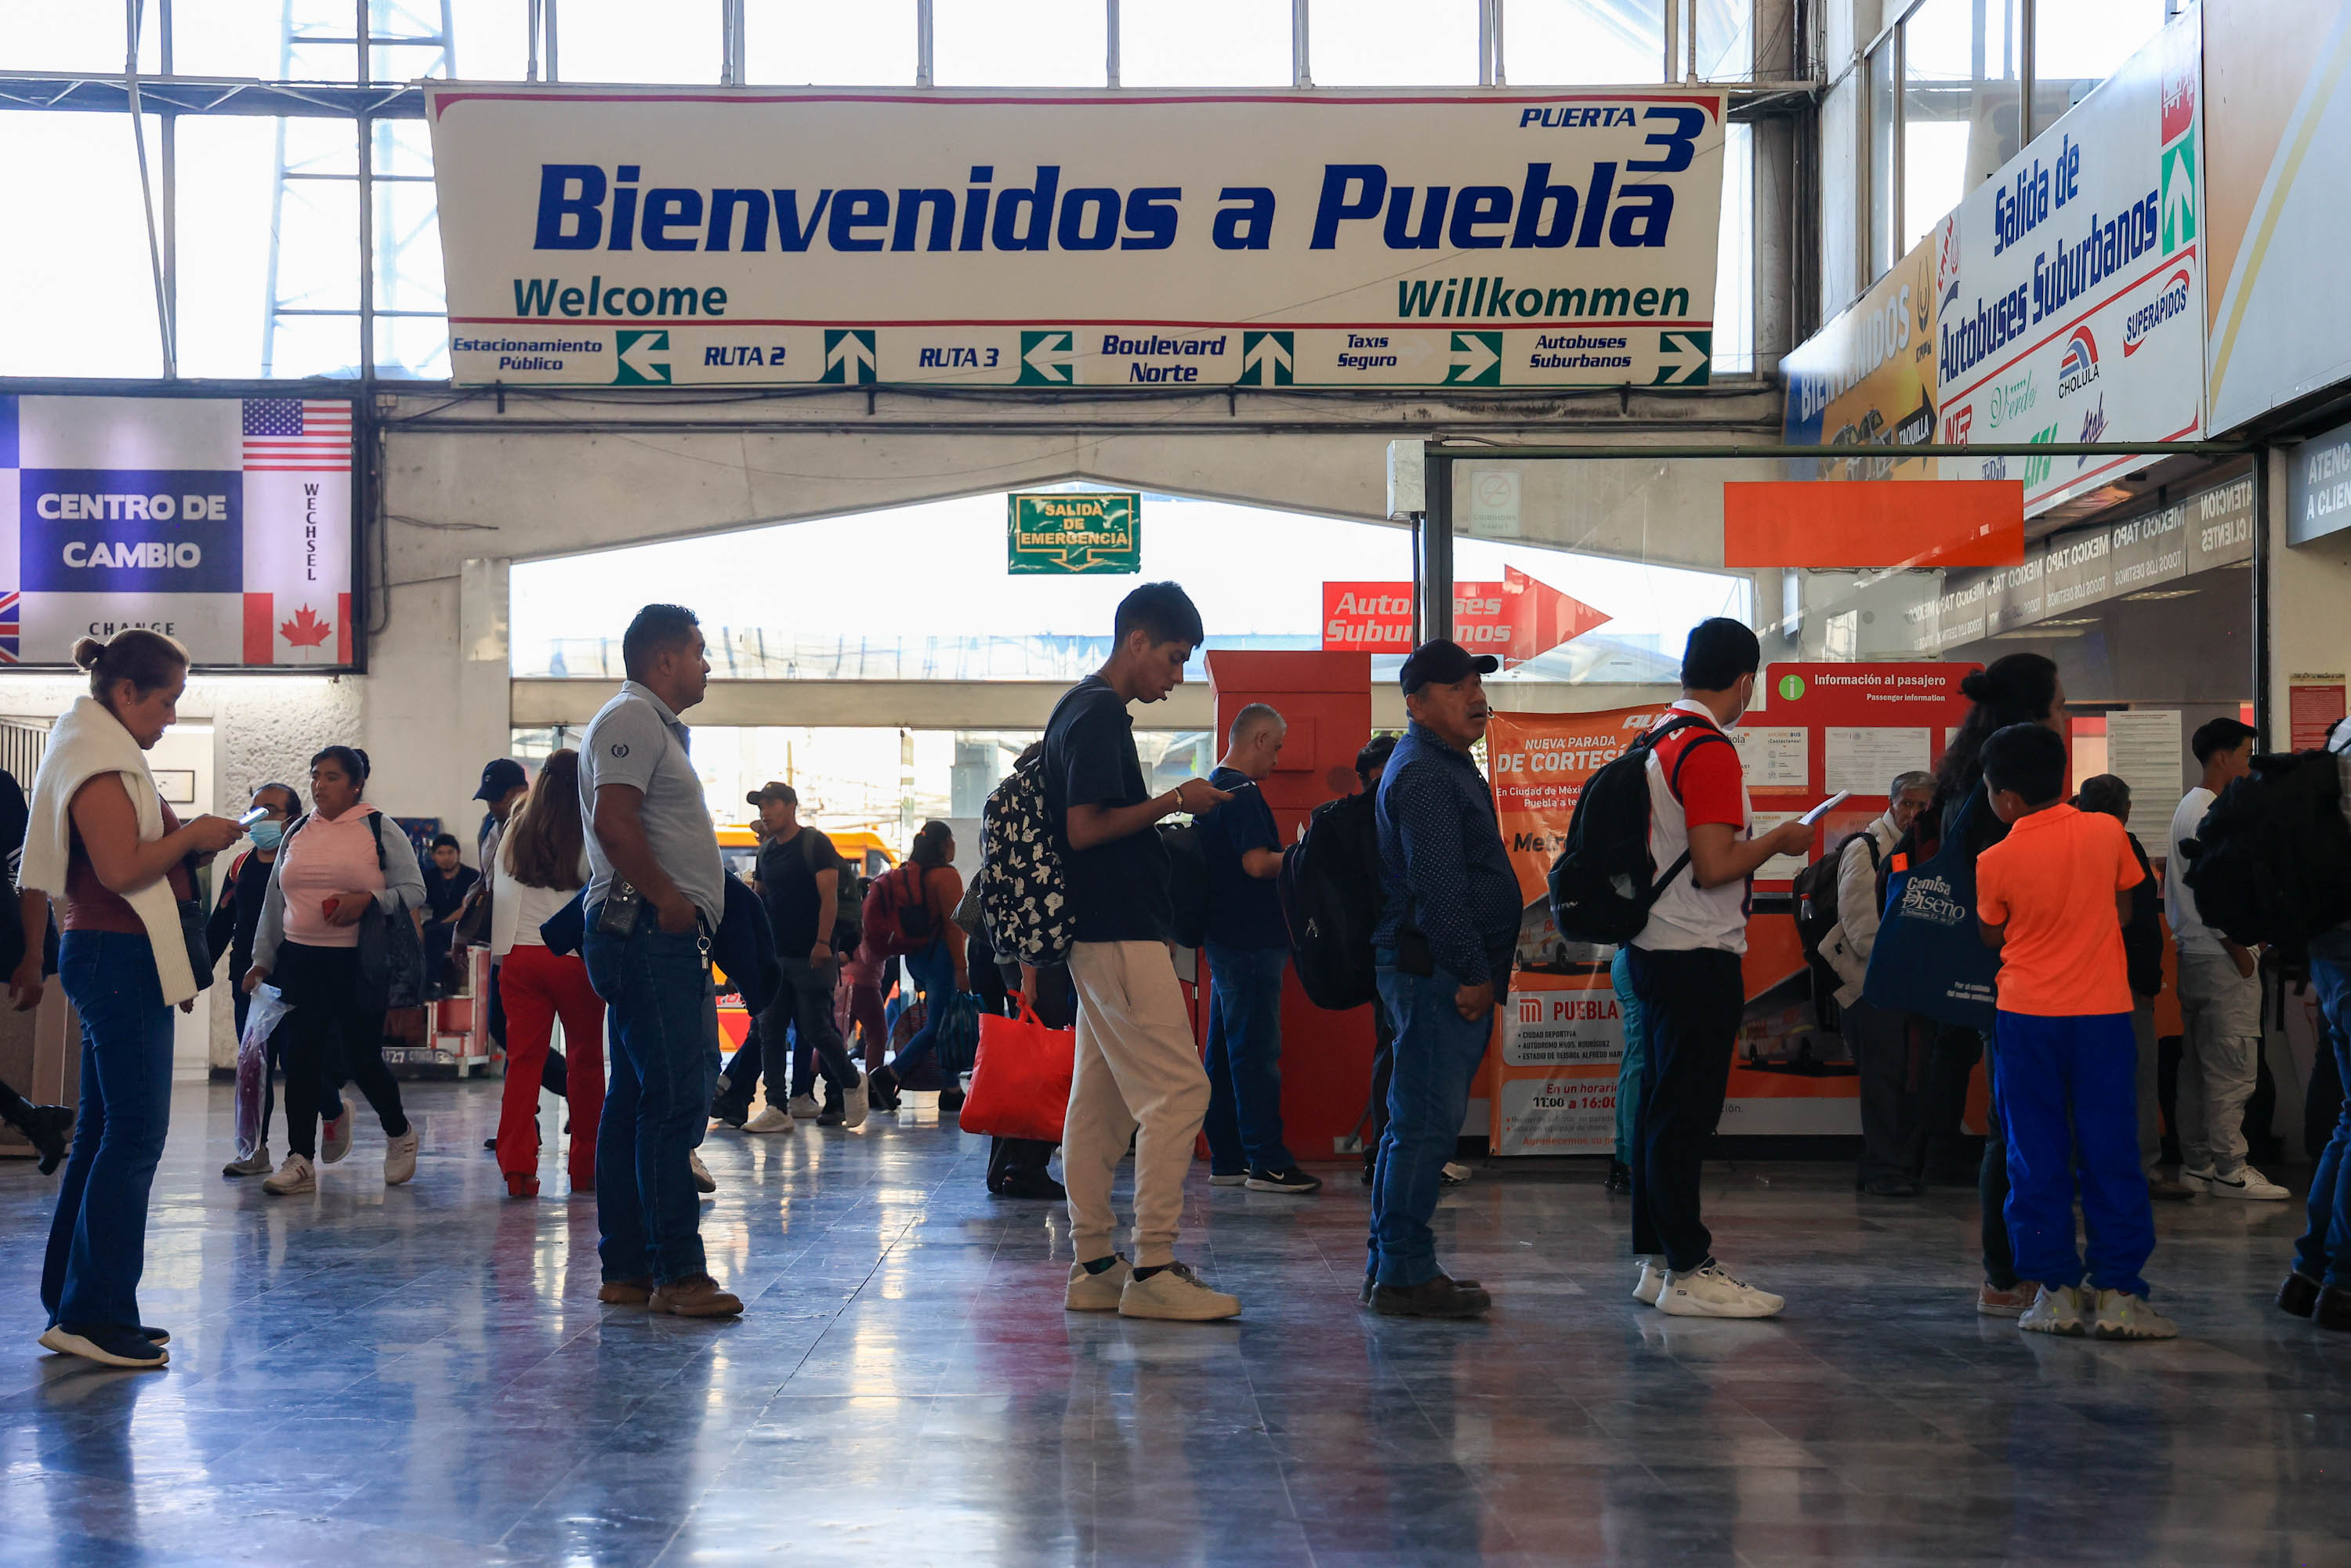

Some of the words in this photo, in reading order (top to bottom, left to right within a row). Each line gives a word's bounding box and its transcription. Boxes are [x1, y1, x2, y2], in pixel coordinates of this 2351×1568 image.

[1519, 107, 1637, 128] PUERTA
[1626, 106, 1706, 172] 3
[1994, 158, 2049, 258] Salida
[2055, 133, 2080, 211] de
[533, 163, 1182, 252] Bienvenidos
[1212, 186, 1276, 251] a
[1309, 161, 1675, 249] Puebla
[513, 276, 727, 317] Welcome
[1397, 277, 1690, 317] Willkommen
[1938, 281, 2027, 389] Autobuses
[2032, 189, 2159, 325] Suburbanos
[2126, 284, 2186, 342] SUPERÁPIDOS
[453, 337, 603, 354] Estacionamiento
[1102, 335, 1226, 356] Boulevard
[1346, 333, 1389, 349] Taxis
[1534, 334, 1627, 349] Autobuses
[498, 354, 564, 371] Público
[704, 346, 764, 367] RUTA
[769, 346, 786, 367] 2
[918, 347, 980, 368] RUTA
[983, 347, 1000, 368] 3
[1338, 350, 1398, 371] Seguro
[1530, 352, 1632, 369] Suburbanos
[1128, 361, 1198, 383] Norte
[2058, 363, 2100, 400] CHOLULA
[36, 493, 176, 520] CENTRO
[183, 494, 227, 520] DE
[1043, 503, 1103, 518] SALIDA
[2306, 494, 2315, 521] A
[303, 483, 320, 581] WECHSEL
[1063, 518, 1085, 531] DE
[1020, 531, 1129, 546] EMERGENCIA
[62, 541, 201, 569] CAMBIO
[1334, 592, 1502, 615] Autoses
[1814, 674, 1882, 686] Información
[1884, 675, 1895, 686] al
[1897, 675, 1946, 687] pasajero
[1867, 693, 1903, 703] Passenger
[1525, 737, 1567, 750] NUEVA
[1568, 735, 1616, 748] PARADA
[1497, 753, 1526, 773] DE
[1496, 788, 1507, 796] En
[1509, 786, 1541, 796] Ciudad
[1545, 786, 1556, 795] de
[1524, 798, 1557, 807] Puebla
[1907, 875, 1951, 896] Camisa
[1900, 889, 1966, 920] Diseño
[1553, 1000, 1619, 1021] PUEBLA
[1545, 1030, 1577, 1038] DEPORTIVA
[1546, 1084, 1560, 1094] En
[1563, 1085, 1577, 1094] un
[1568, 1099, 1577, 1110] a
